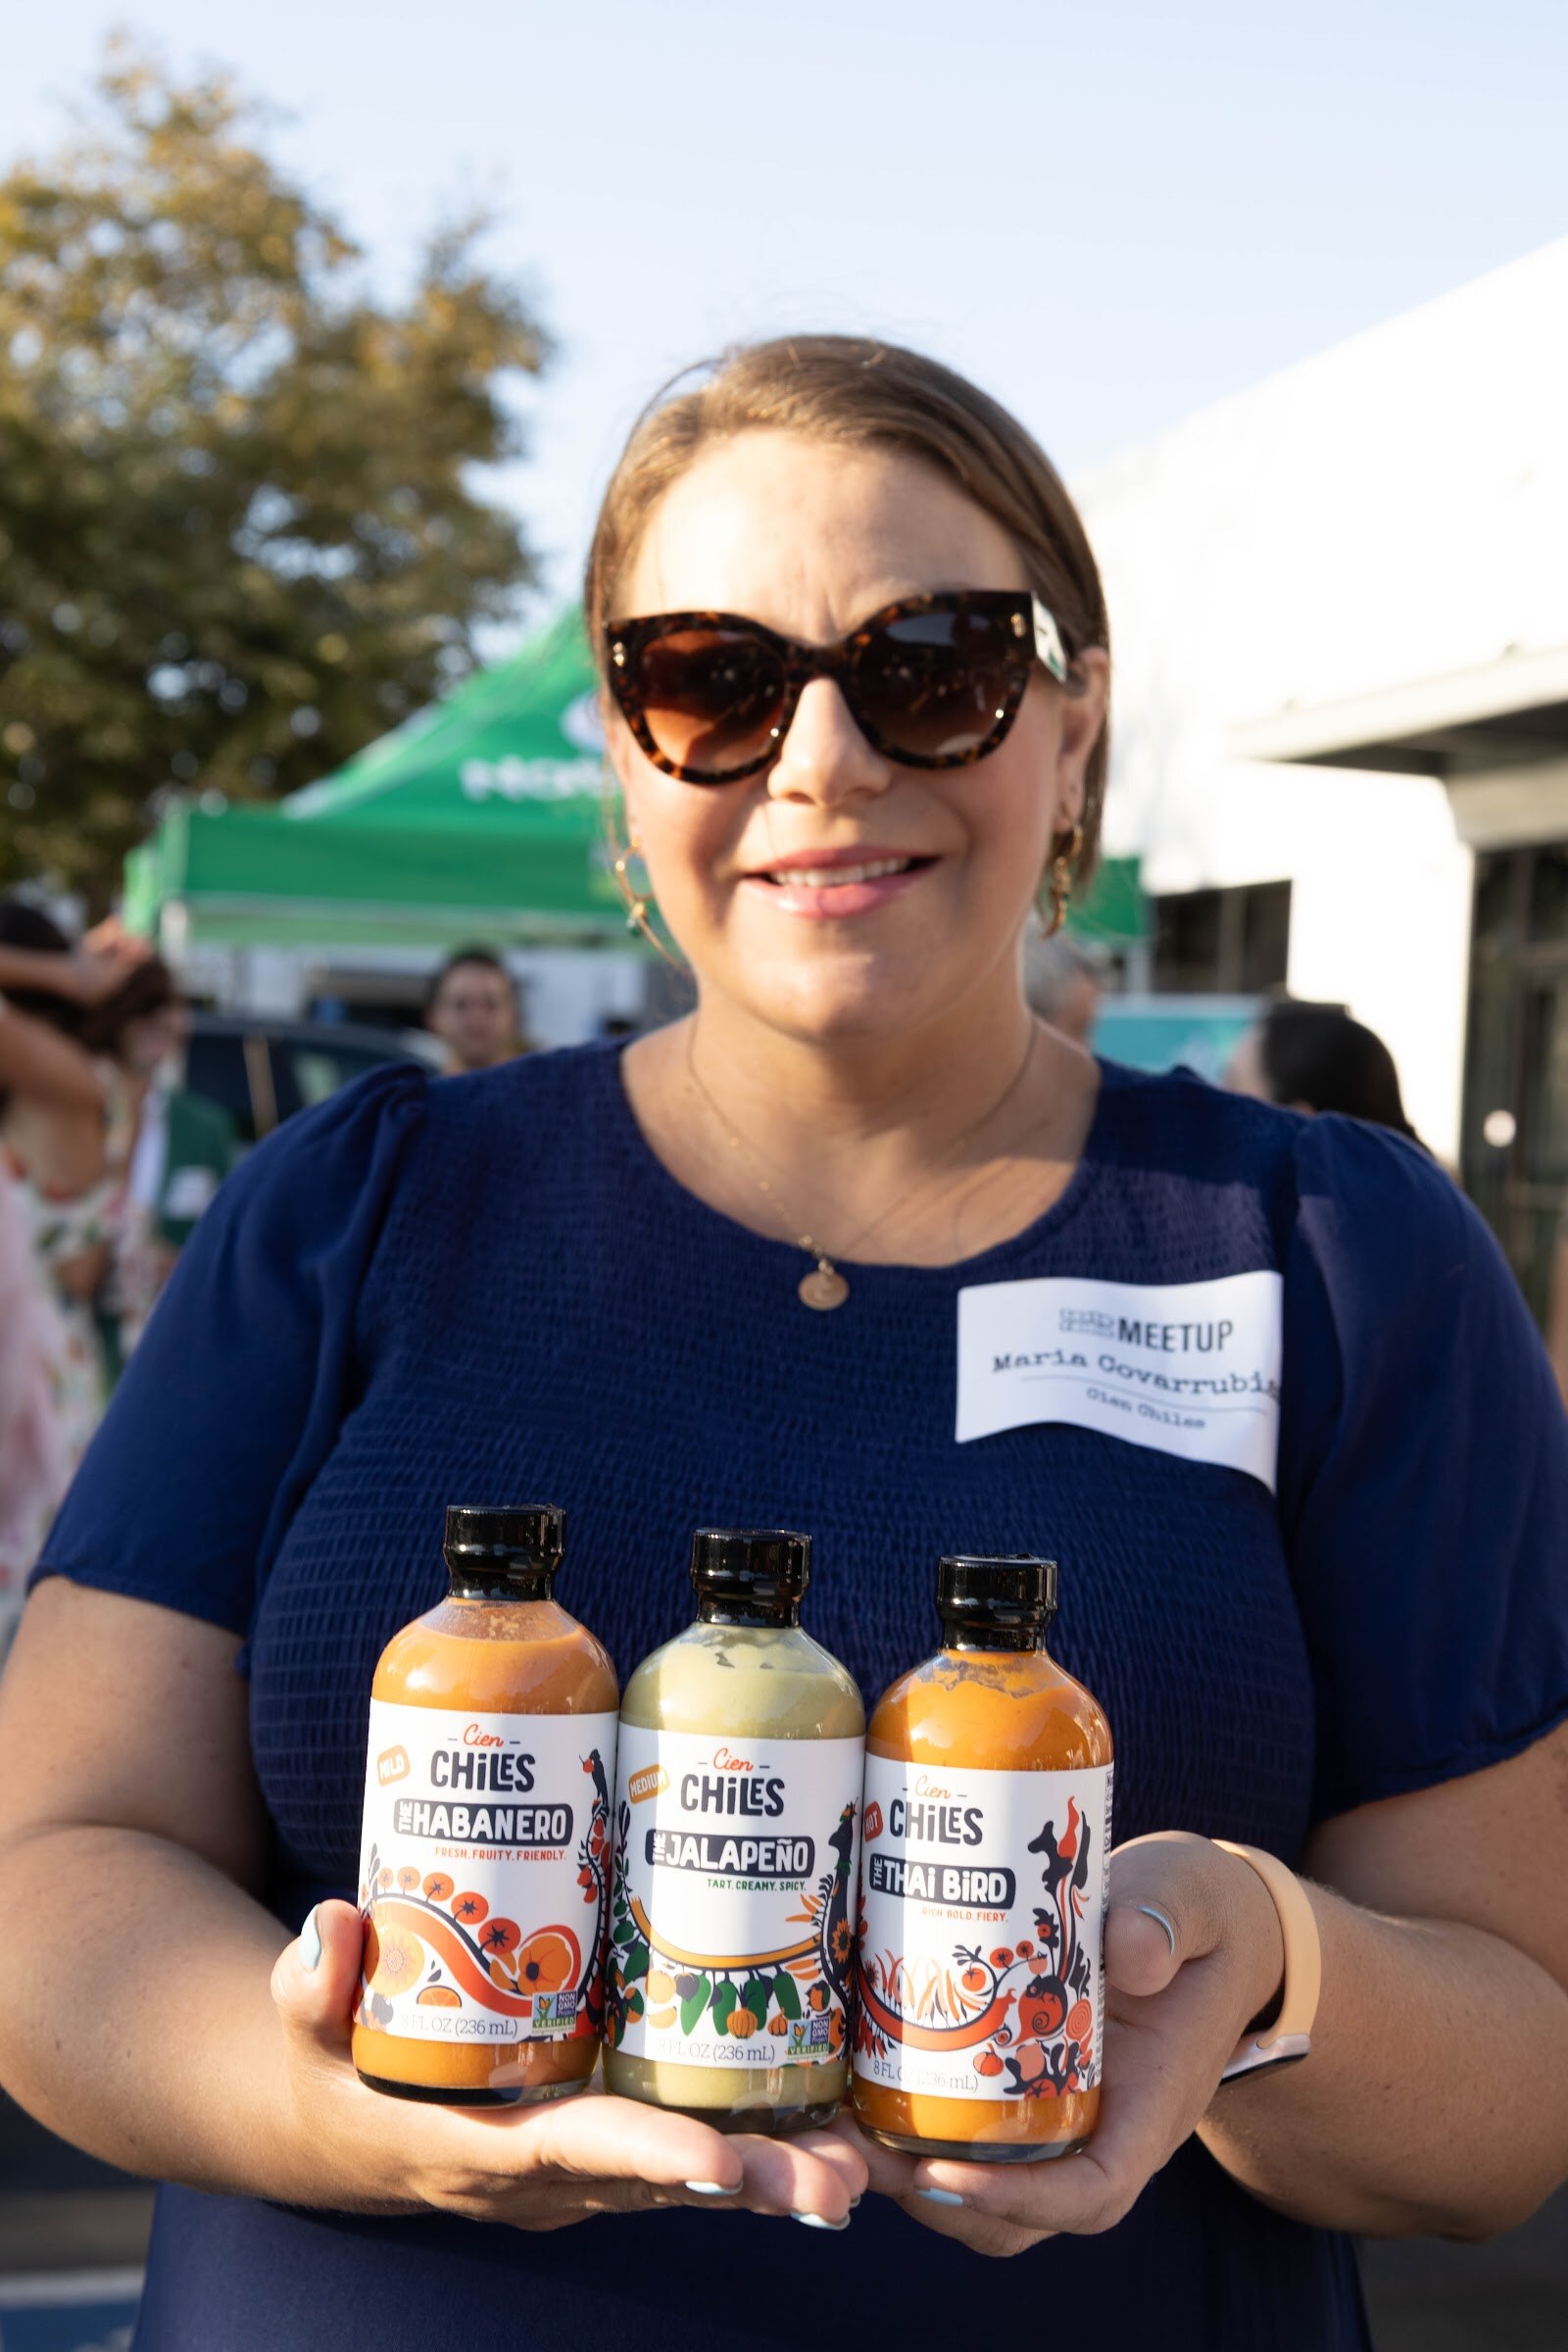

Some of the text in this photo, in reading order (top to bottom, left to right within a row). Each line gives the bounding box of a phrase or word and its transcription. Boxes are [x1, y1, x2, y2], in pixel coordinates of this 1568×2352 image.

[1117, 1316, 1234, 1352] MEETUP
[992, 1347, 1088, 1373] Maria
[463, 1723, 504, 1747] Cien
[712, 1747, 754, 1772] Cien
[914, 1775, 951, 1799] Cien
[398, 1800, 566, 1840] THE HABANERO
[864, 1810, 879, 1835] HOT
[665, 1834, 809, 1873] JALAPEÑO
[872, 1857, 883, 1886] THE
[559, 1993, 576, 2002] NON
[431, 2017, 452, 2034] OZ
[455, 2019, 486, 2036] (236
[490, 2019, 518, 2038] mL)
[534, 2017, 574, 2028] VERIFIED
[689, 2042, 710, 2059] OZ
[712, 2042, 744, 2062] (236
[747, 2043, 775, 2064] mL)
[873, 2060, 880, 2076] 8
[882, 2063, 895, 2080] FL
[950, 2075, 979, 2093] mL)
